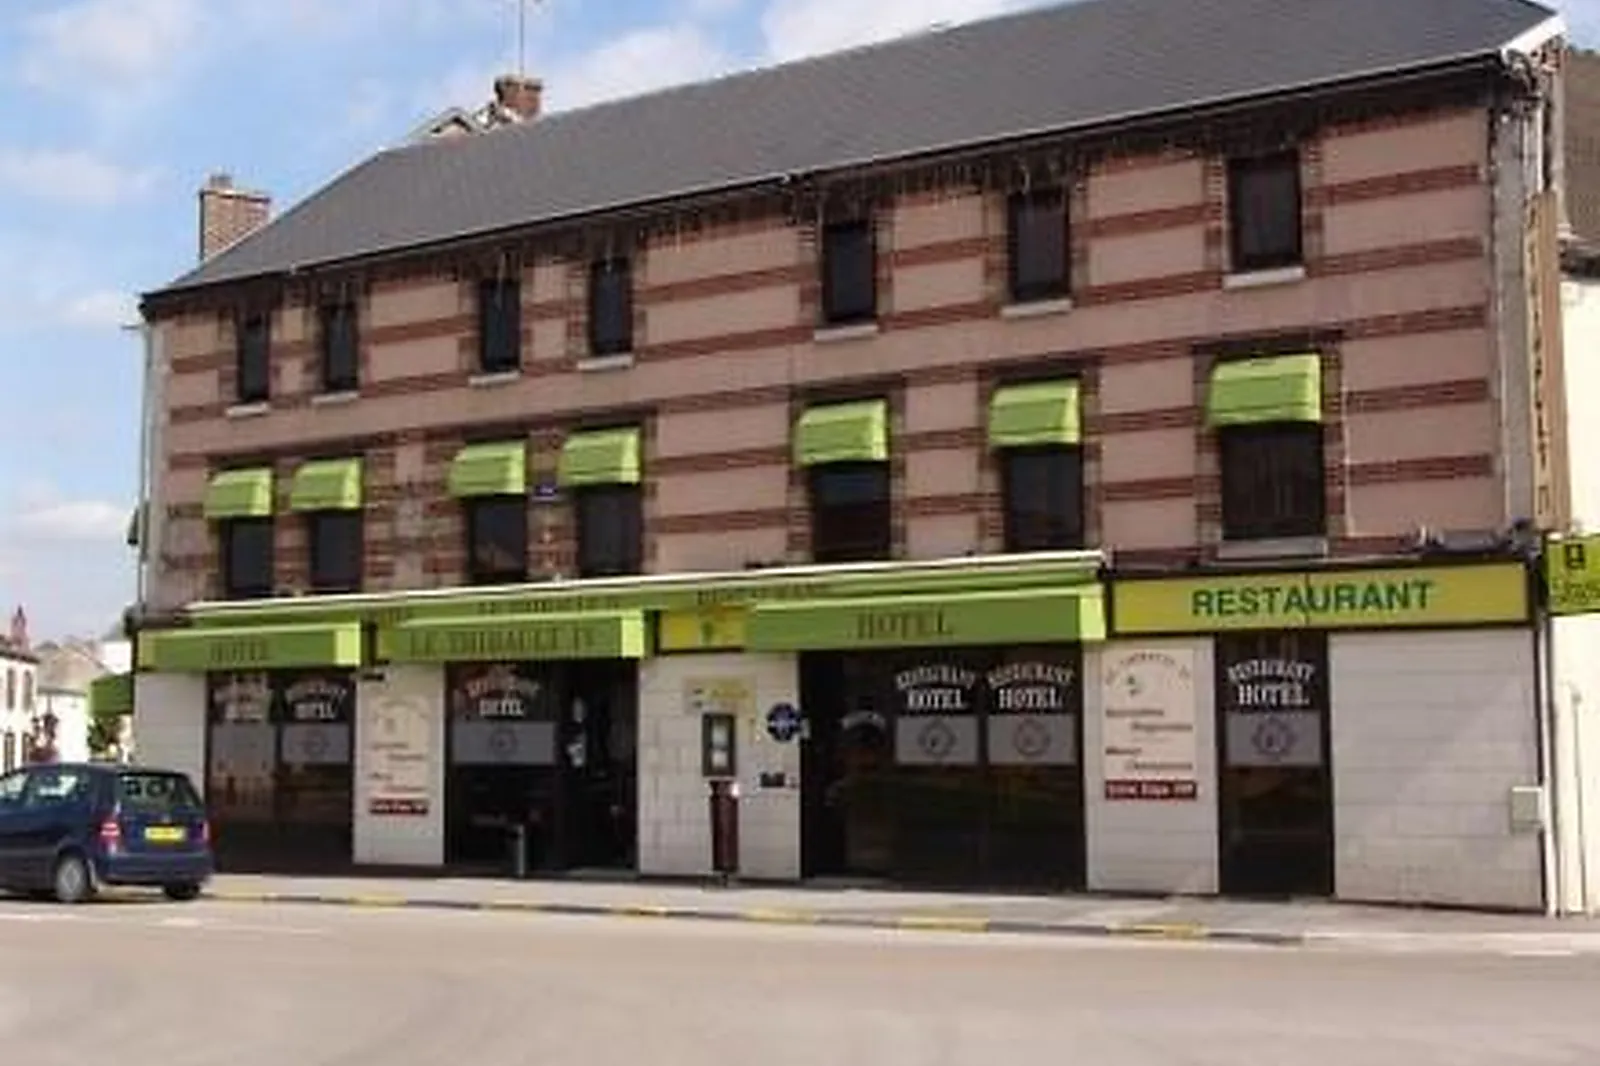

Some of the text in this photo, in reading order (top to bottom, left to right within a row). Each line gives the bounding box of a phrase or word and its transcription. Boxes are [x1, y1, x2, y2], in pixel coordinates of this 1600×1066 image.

[1192, 580, 1432, 616] RESTAURANT
[857, 608, 953, 640] HOTEL
[1227, 658, 1315, 683] RESTAURANT
[907, 687, 967, 710] HOTEL
[998, 686, 1064, 710] HOTEL
[1238, 682, 1310, 706] HOTEL
